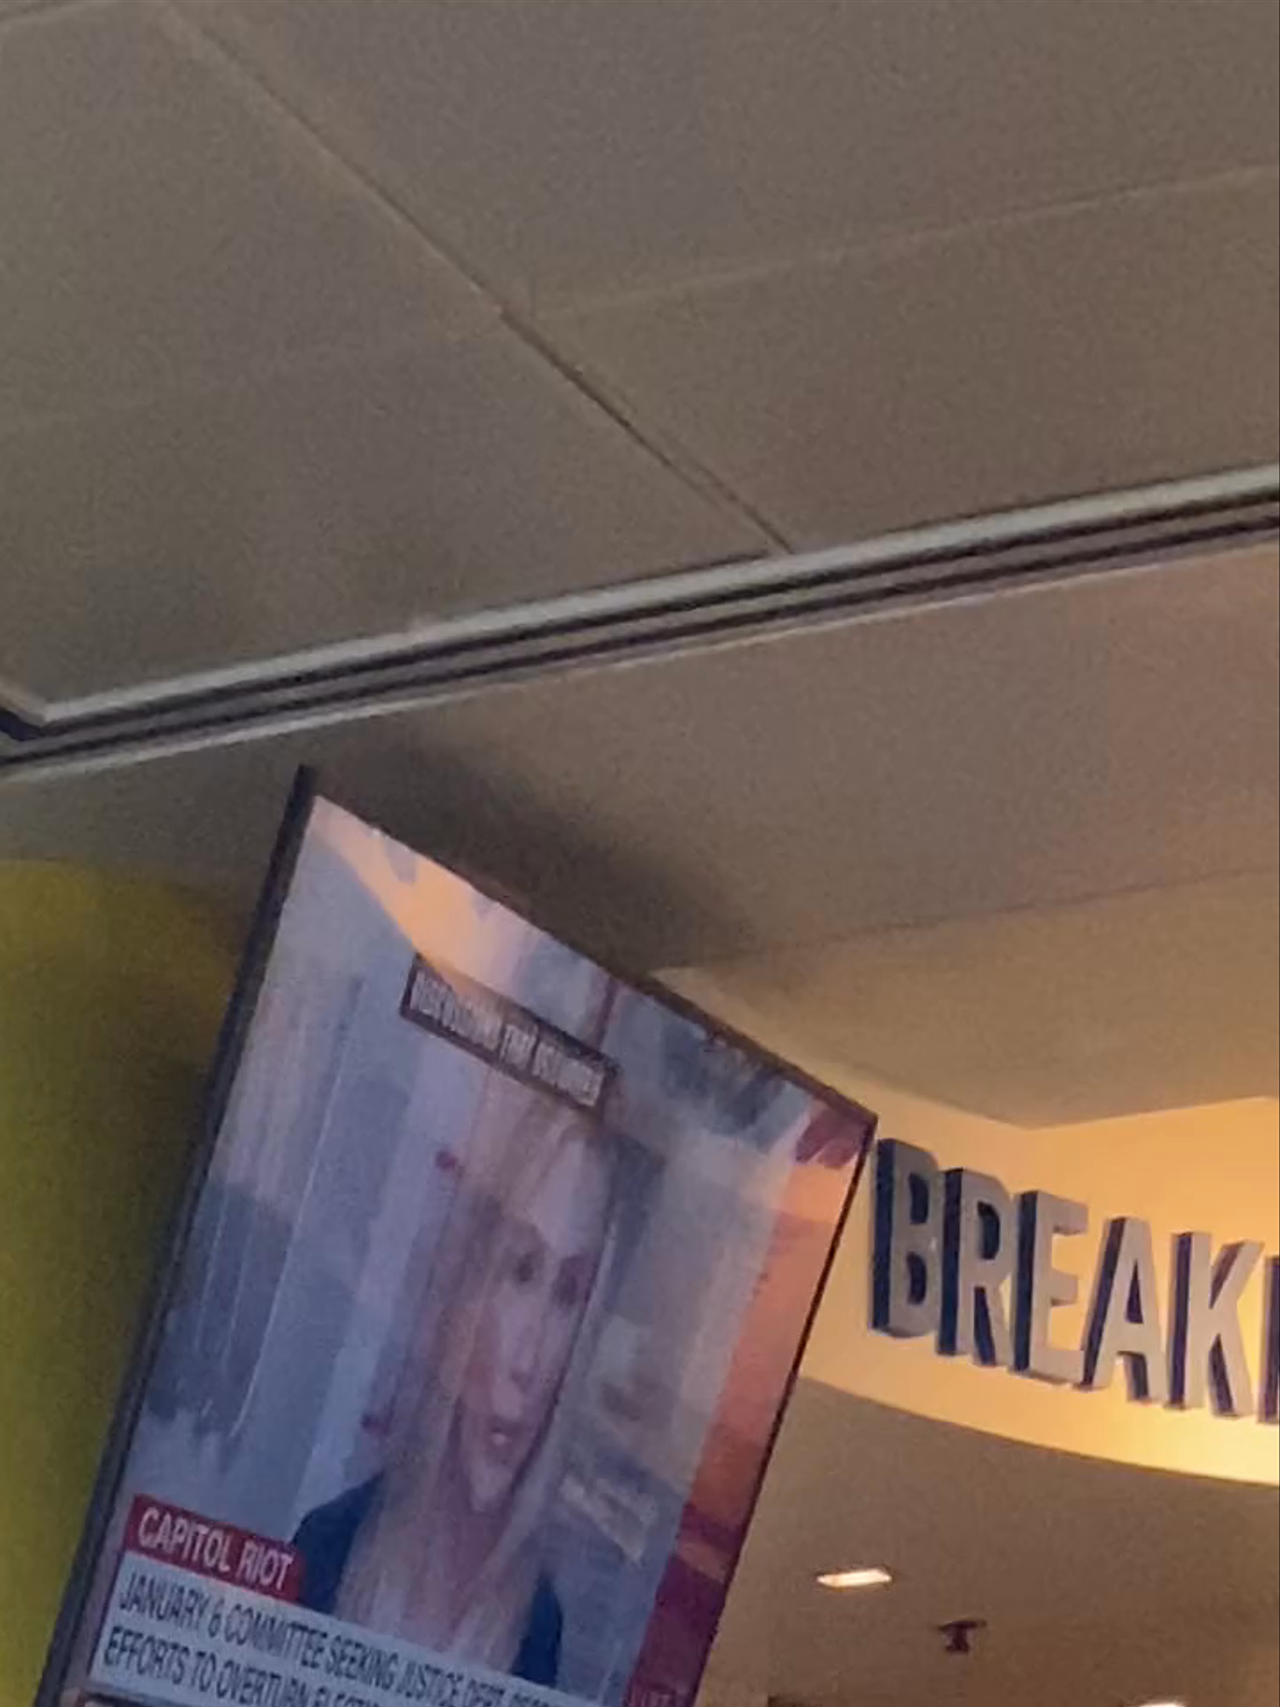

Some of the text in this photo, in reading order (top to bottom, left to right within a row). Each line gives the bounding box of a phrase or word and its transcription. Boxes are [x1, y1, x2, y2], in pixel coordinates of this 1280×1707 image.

[137, 1507, 292, 1591] CAPITOL RIOT
[105, 1628, 189, 1685] EFFORTS
[190, 1654, 220, 1694] TO
[121, 1571, 207, 1631] JANUARY
[208, 1601, 224, 1635] 6
[224, 1605, 327, 1668] COMMITTEE
[326, 1638, 398, 1691] SEEKING
